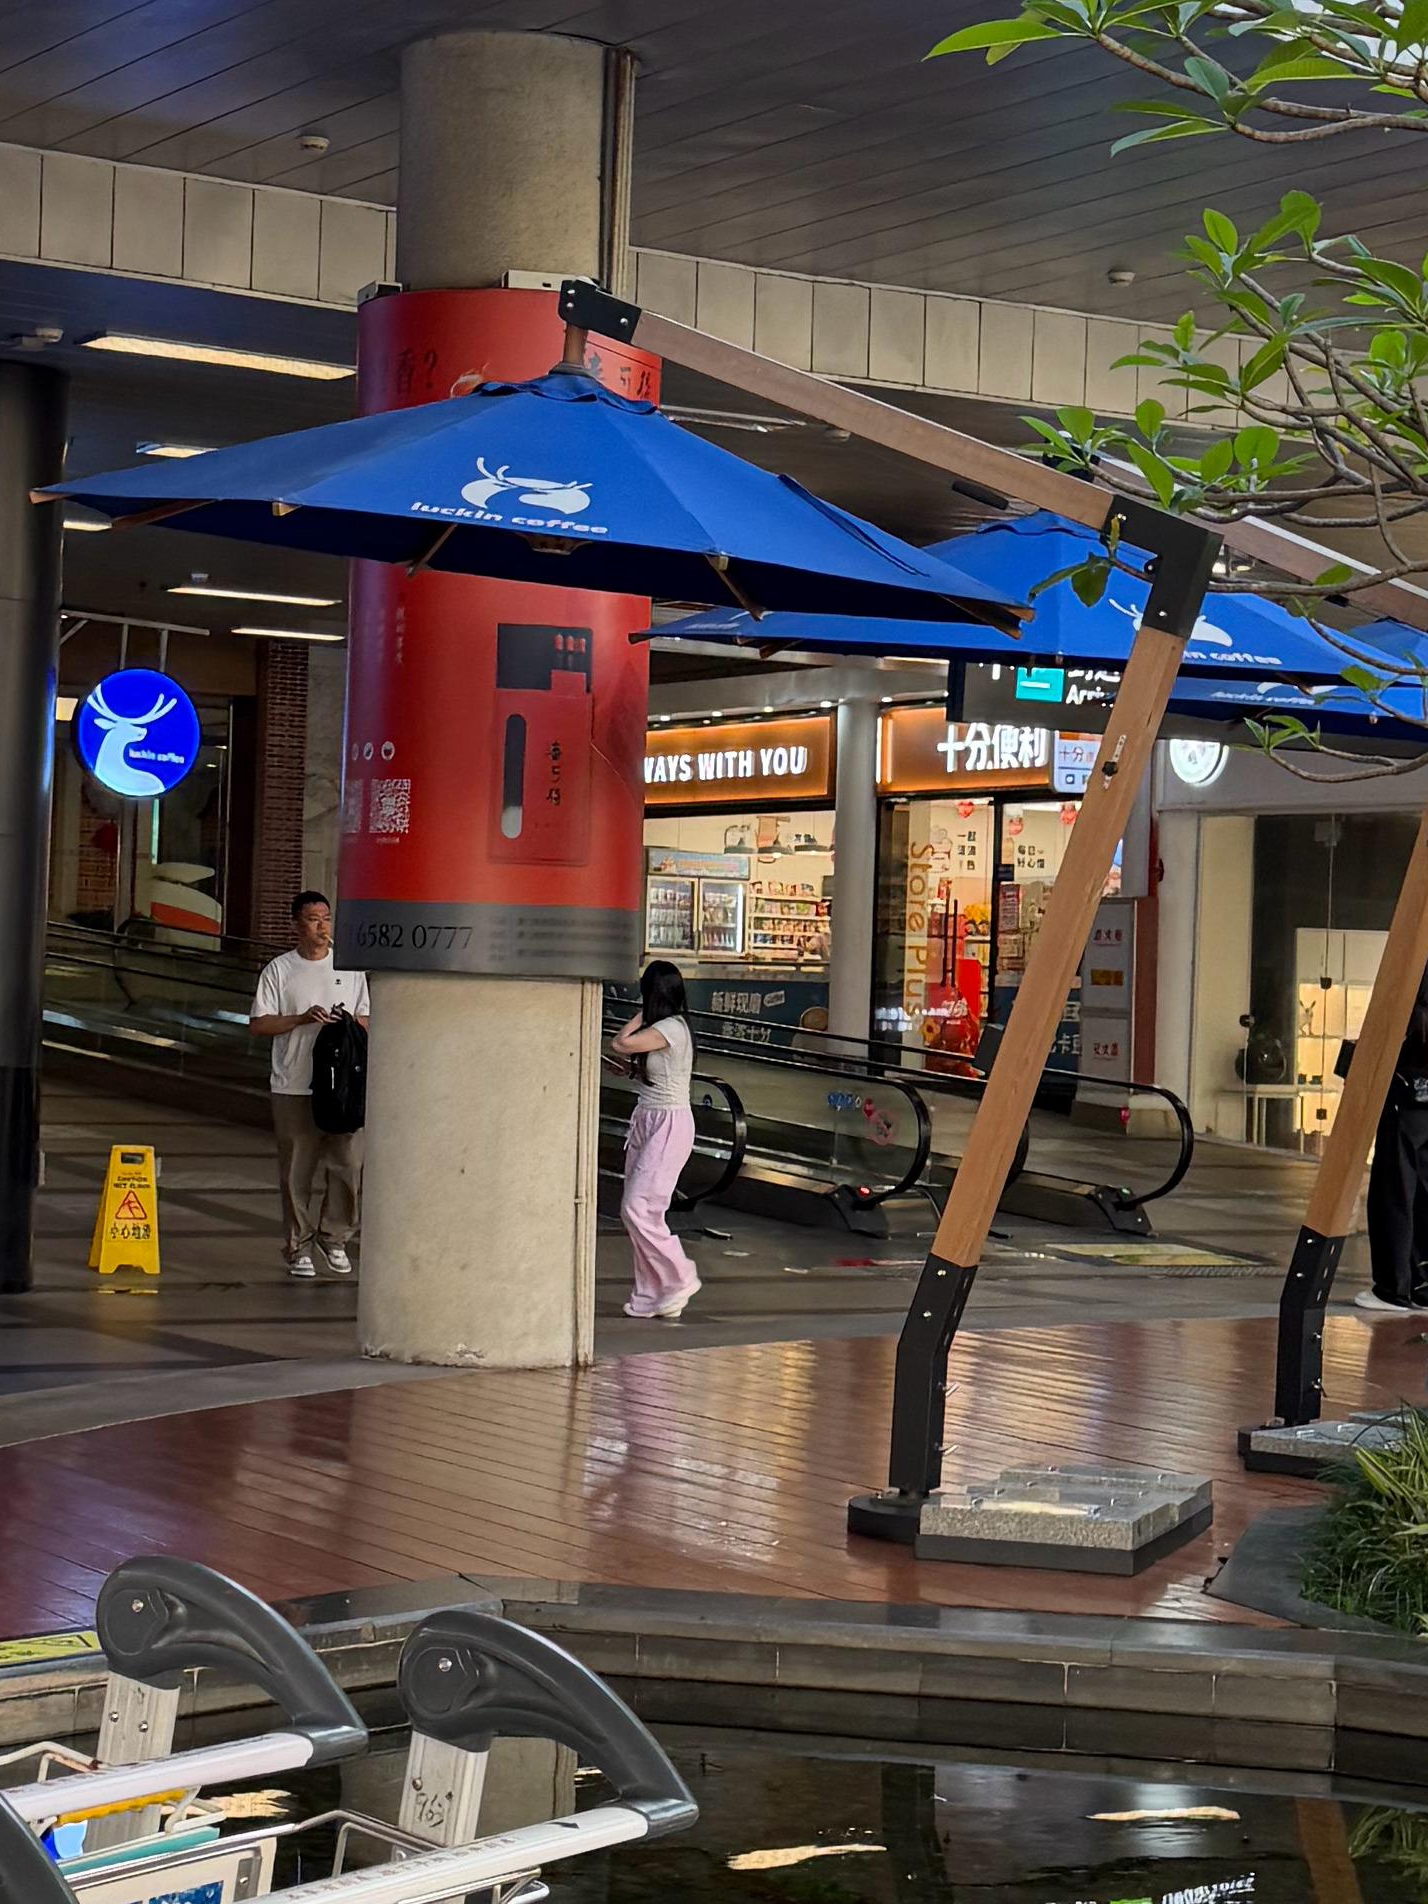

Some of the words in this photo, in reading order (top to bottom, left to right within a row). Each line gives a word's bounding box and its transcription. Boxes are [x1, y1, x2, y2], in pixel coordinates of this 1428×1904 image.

[409, 500, 504, 523] luckin
[510, 516, 609, 535] coffee
[697, 749, 753, 782] WITH
[759, 745, 808, 777] YOU
[936, 722, 1051, 773] 十分便利
[907, 840, 935, 933] Store
[412, 925, 474, 950] 0777
